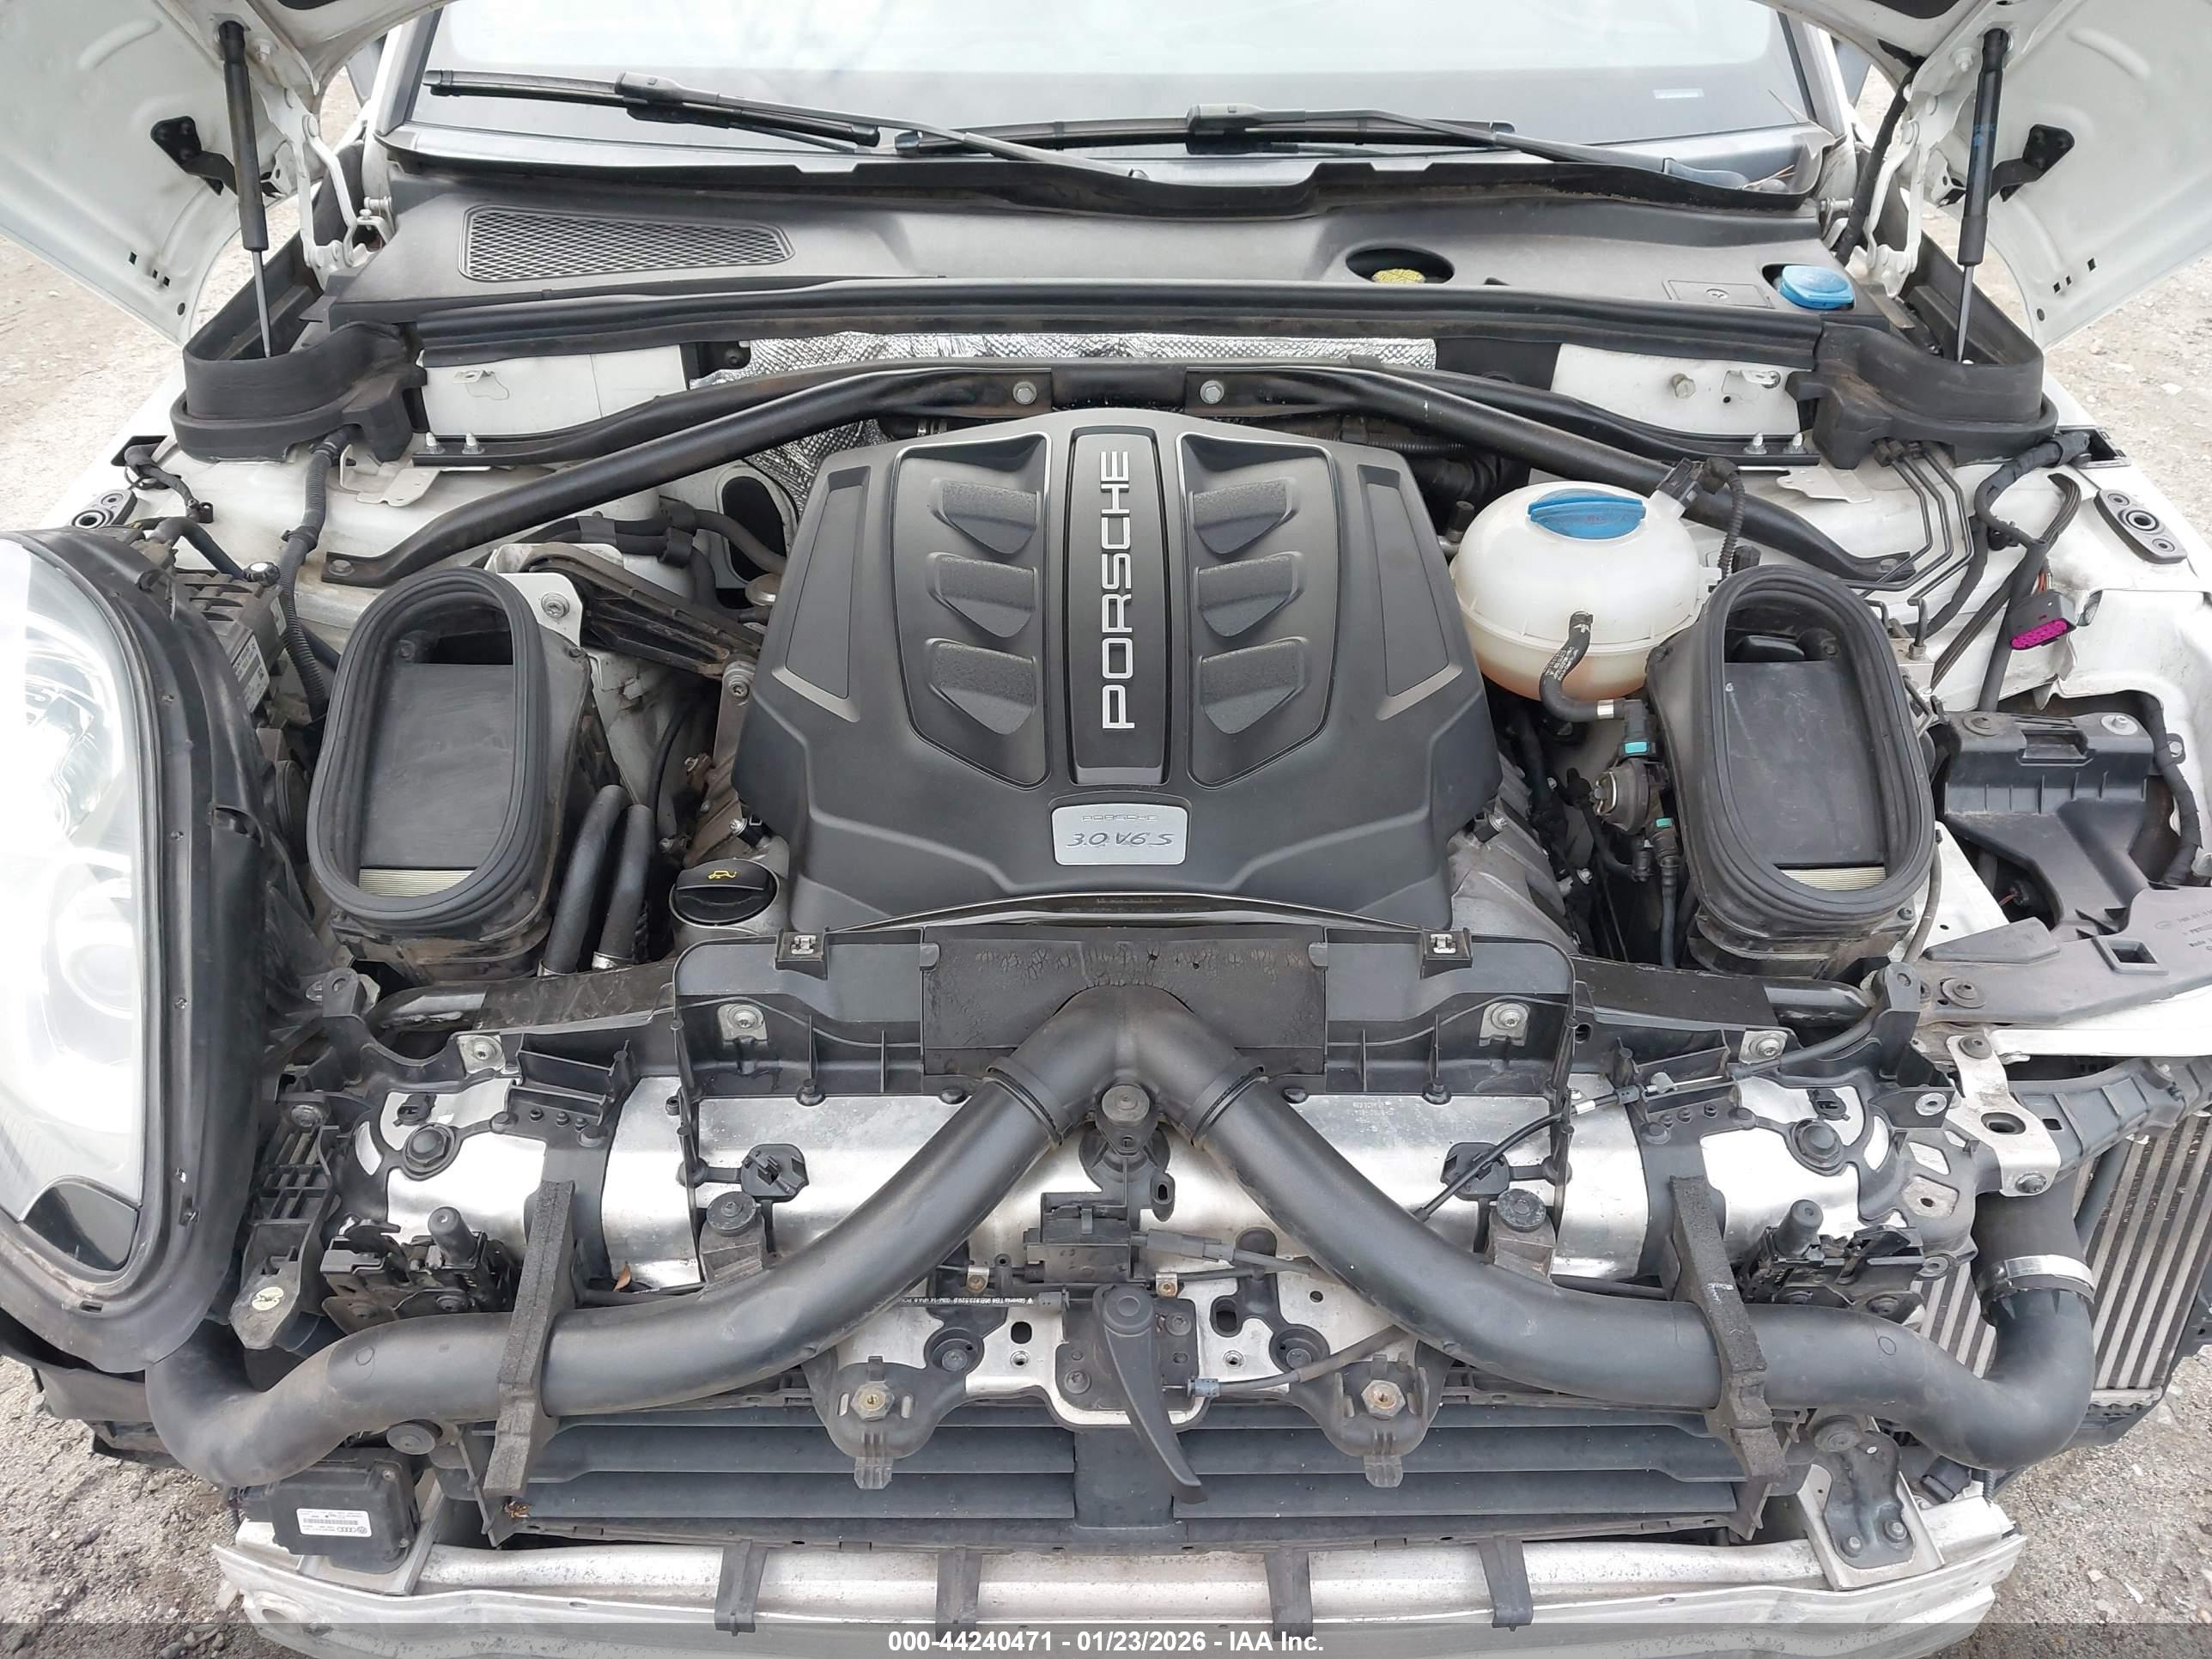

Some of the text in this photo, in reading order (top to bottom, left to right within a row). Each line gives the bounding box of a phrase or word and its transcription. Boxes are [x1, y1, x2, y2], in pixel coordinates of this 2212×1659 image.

[1100, 450, 1135, 730] PORSCHE
[1066, 831, 1110, 848] 3.0
[1115, 831, 1149, 848] V6
